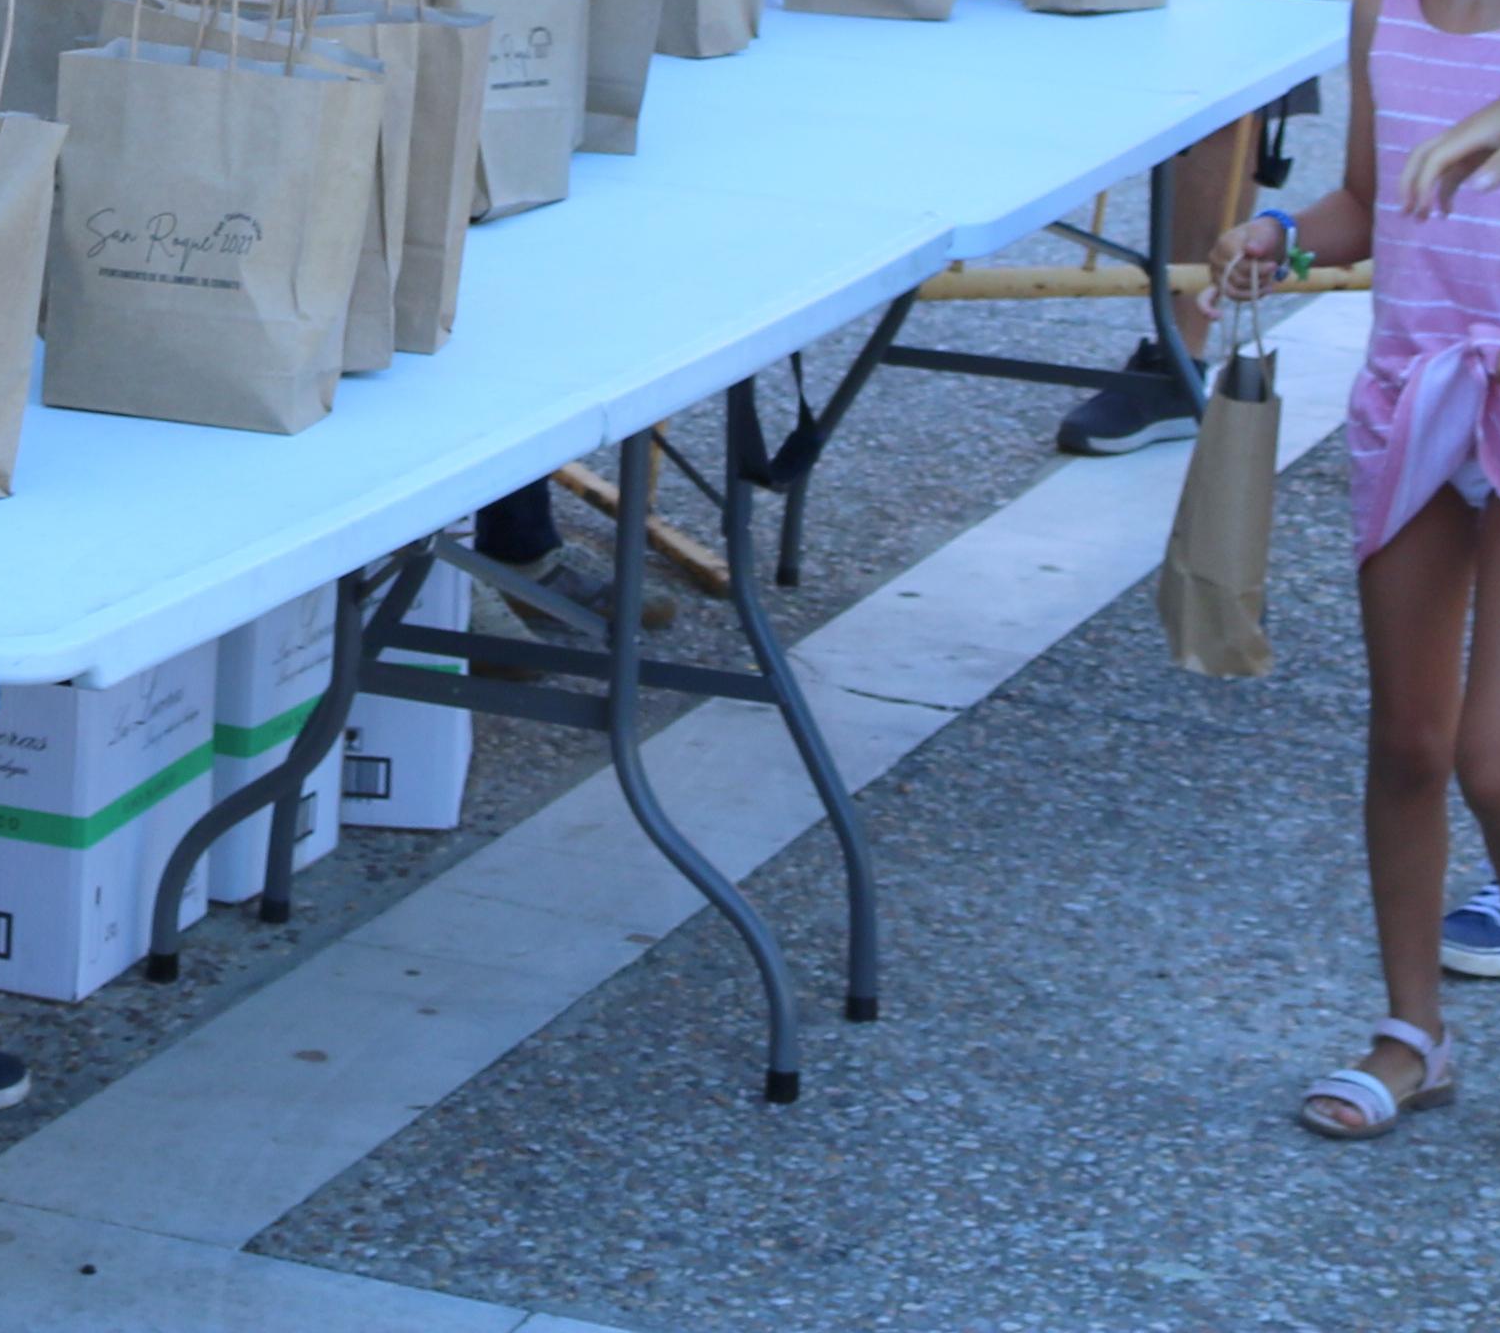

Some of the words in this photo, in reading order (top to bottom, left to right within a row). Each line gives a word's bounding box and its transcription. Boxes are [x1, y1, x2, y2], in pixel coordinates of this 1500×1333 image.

[86, 208, 137, 258] San
[147, 212, 213, 272] Roque
[219, 233, 254, 255] 2021
